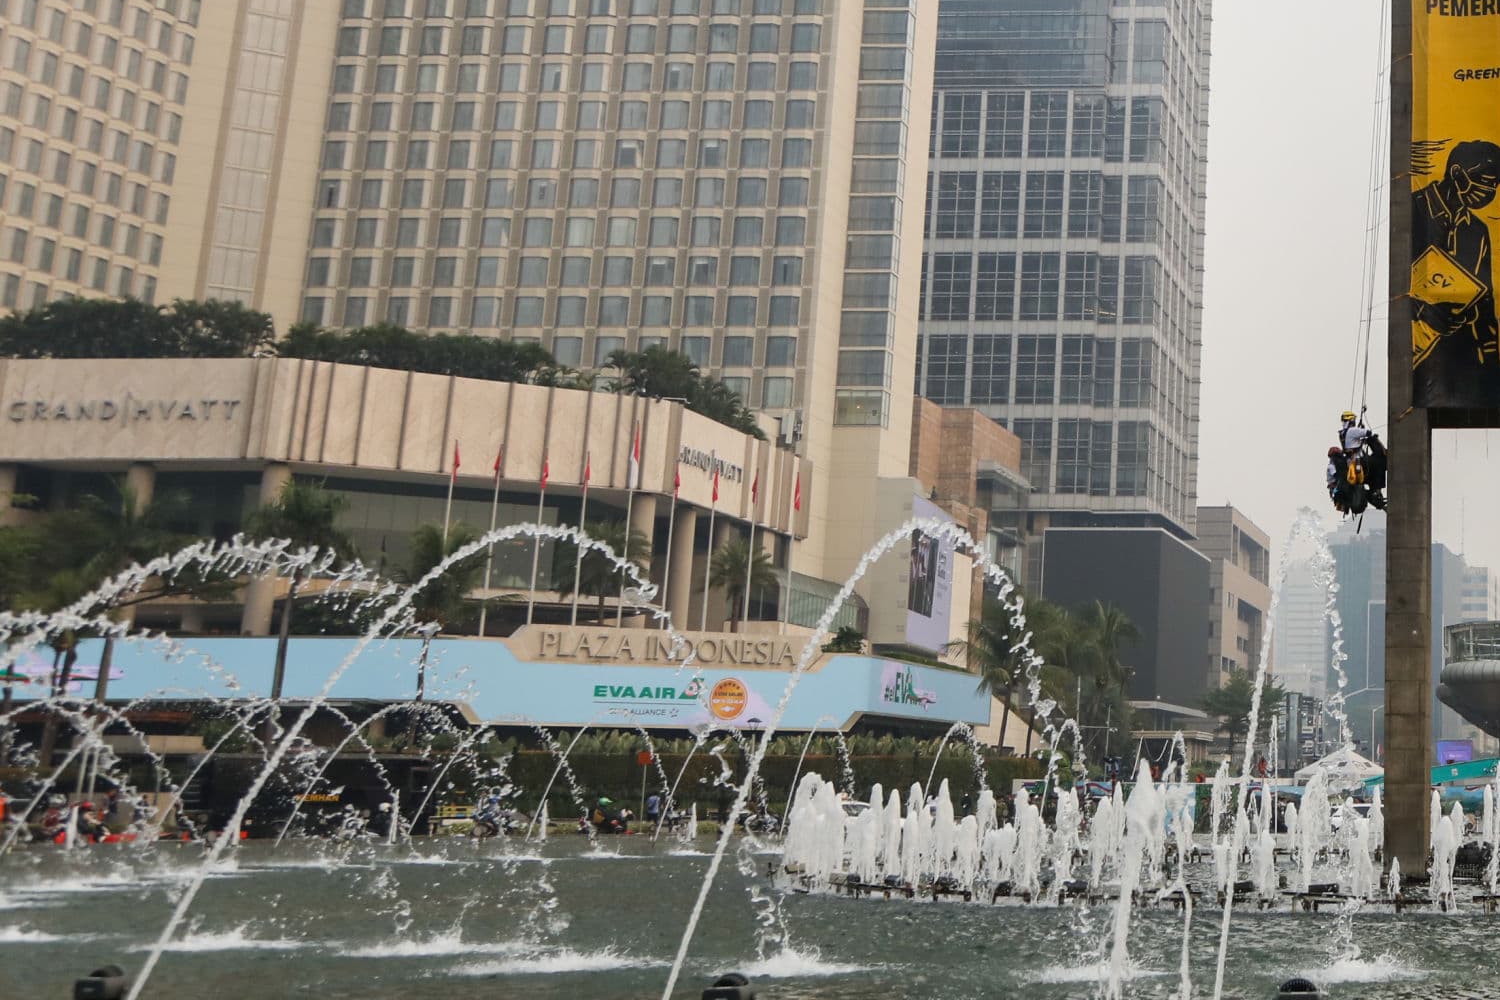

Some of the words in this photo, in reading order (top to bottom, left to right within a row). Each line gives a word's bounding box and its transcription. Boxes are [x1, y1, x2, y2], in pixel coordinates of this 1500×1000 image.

[1432, 273, 1452, 288] CV
[7, 400, 118, 423] GRAND
[132, 400, 241, 422] HYATT
[540, 631, 636, 660] PLAZA
[645, 636, 797, 667] INDONESIA
